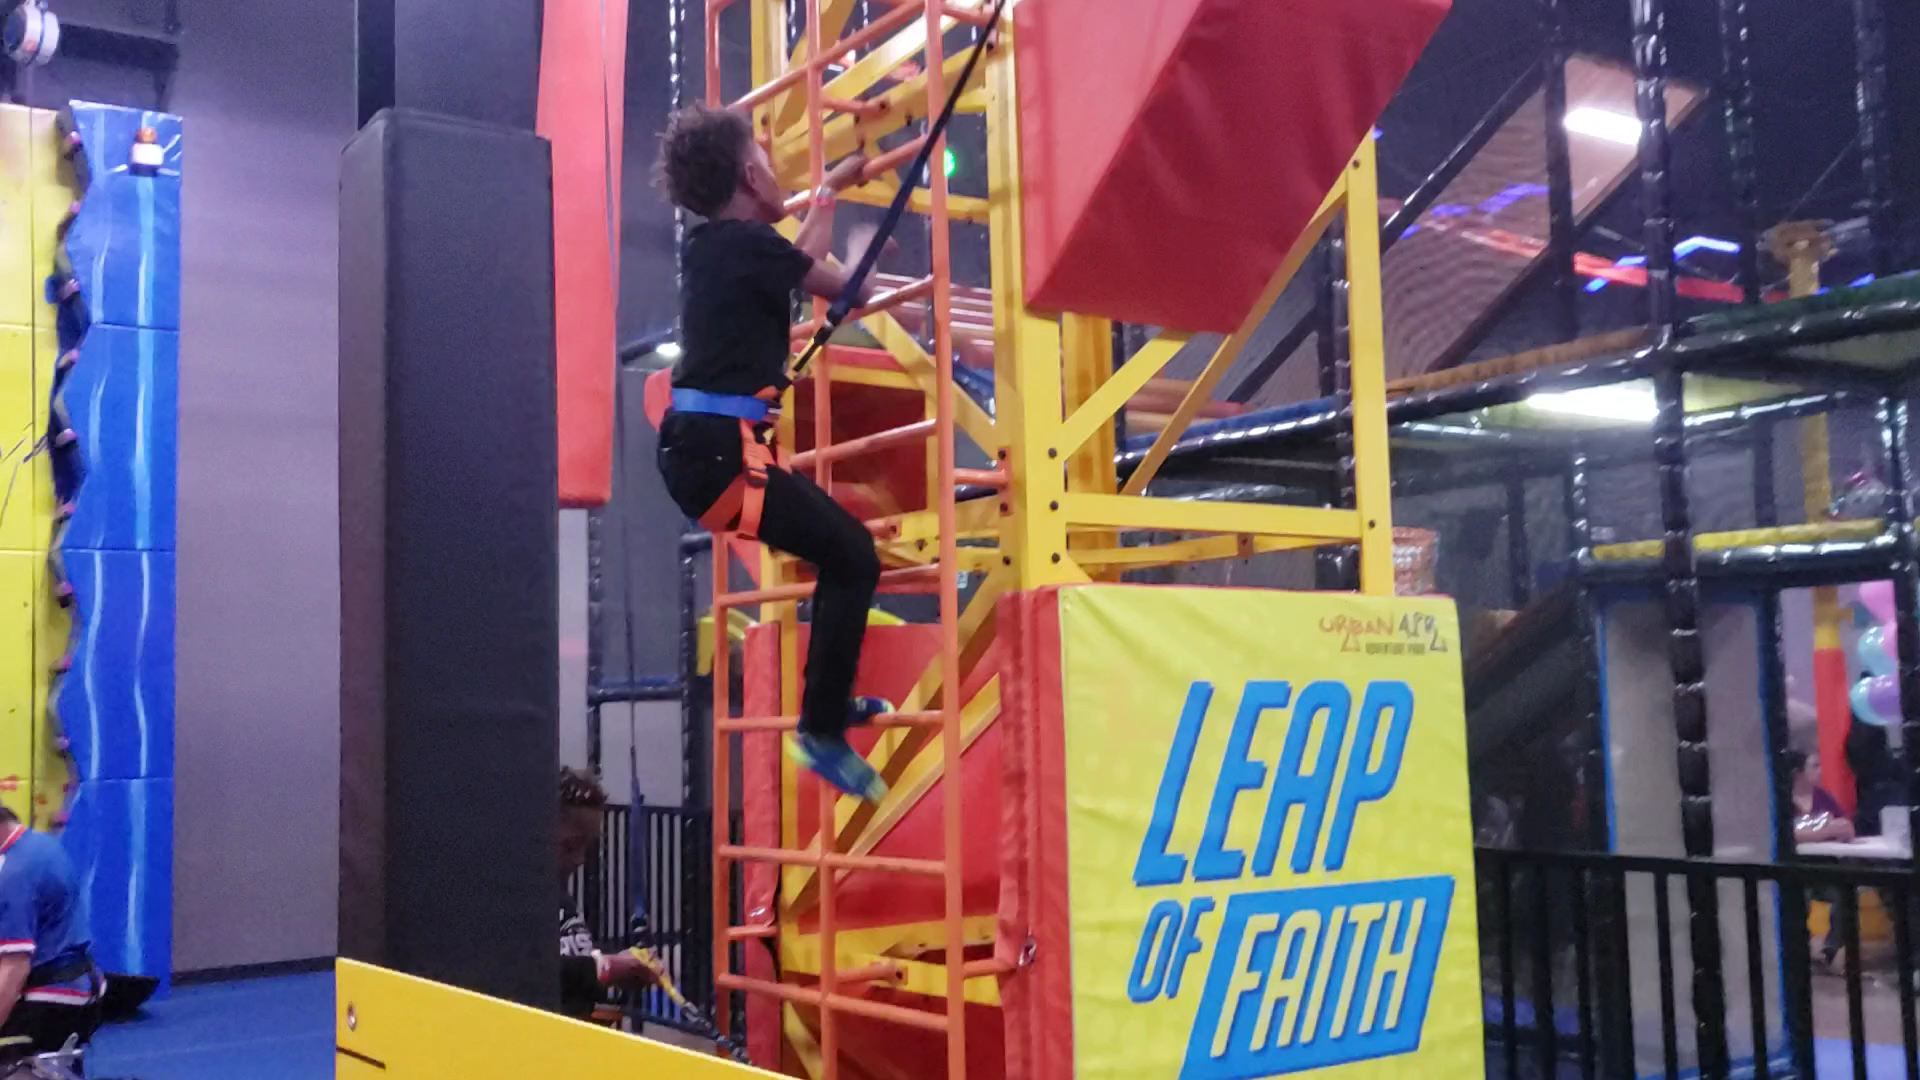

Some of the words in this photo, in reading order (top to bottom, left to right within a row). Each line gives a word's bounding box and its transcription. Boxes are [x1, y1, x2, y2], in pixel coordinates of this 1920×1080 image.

[1318, 611, 1394, 652] URBAN
[1133, 680, 1415, 887] LEAP
[1127, 896, 1216, 1004] OF
[1211, 898, 1427, 1058] FAITH
